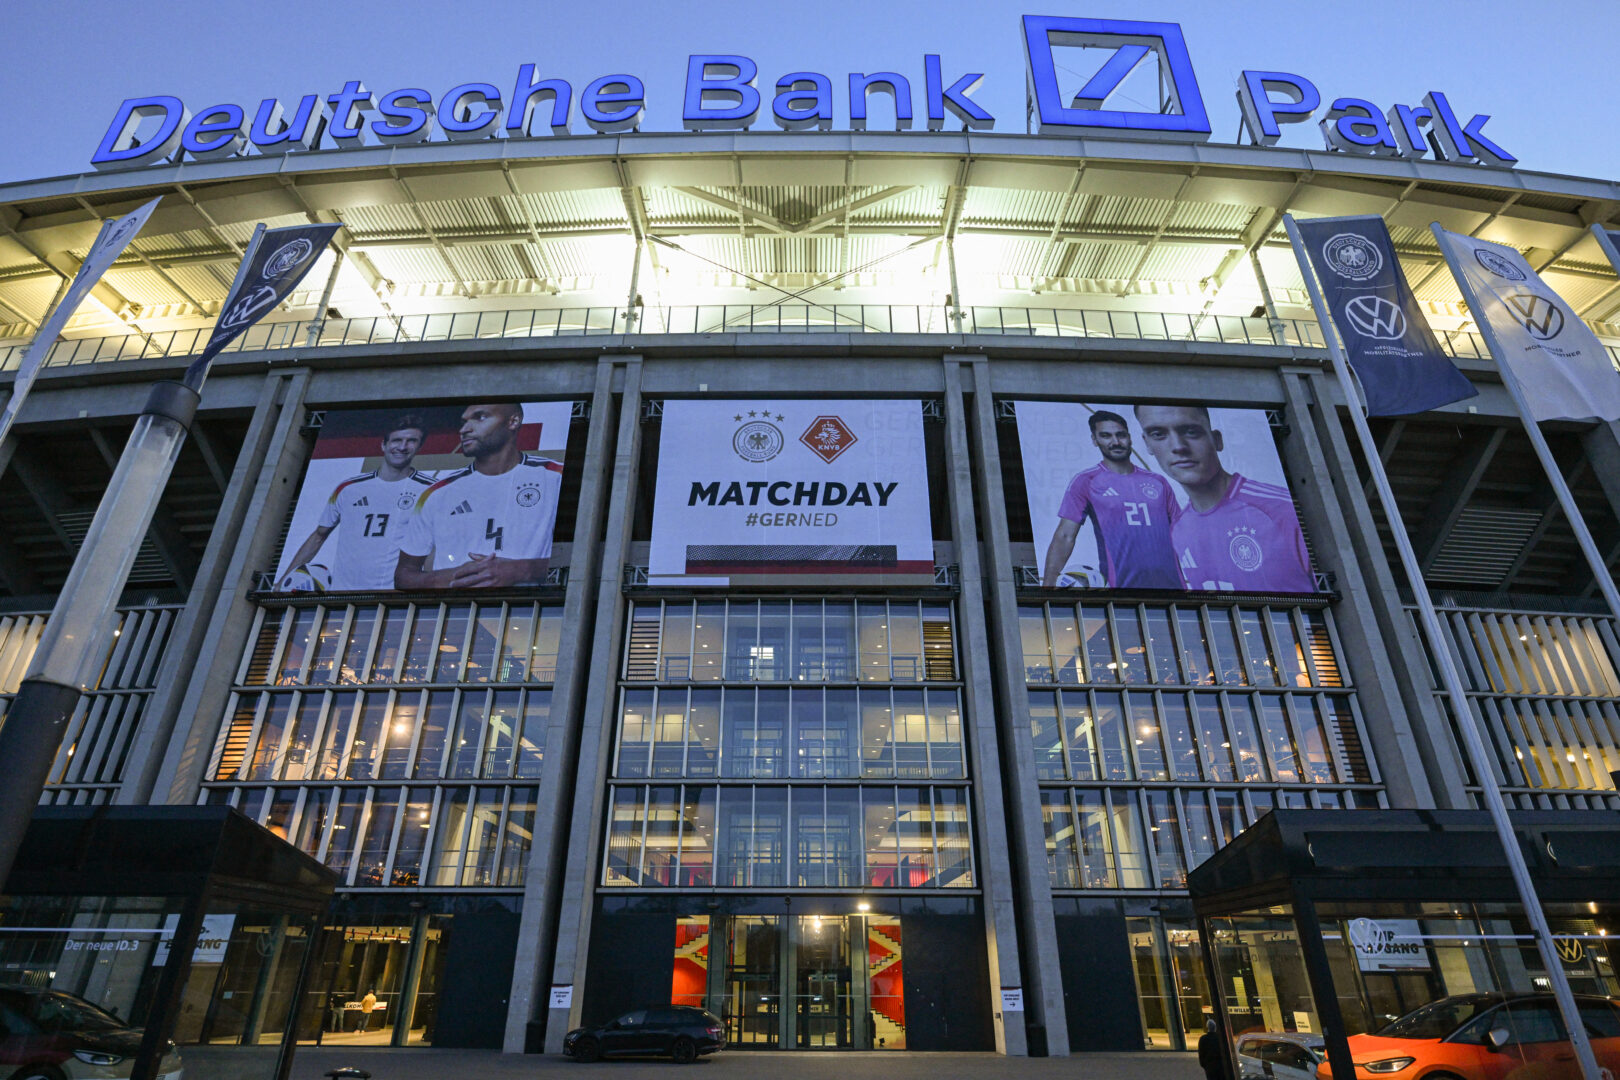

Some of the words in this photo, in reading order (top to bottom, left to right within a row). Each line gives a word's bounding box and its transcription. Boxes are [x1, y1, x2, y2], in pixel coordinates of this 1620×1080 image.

[91, 63, 646, 168] Deutsche
[682, 53, 995, 132] Bank
[1239, 69, 1518, 168] Park
[687, 481, 899, 507] MATCHDAY
[363, 513, 390, 537] 13
[745, 512, 838, 527] #GERNED
[1123, 502, 1151, 526] 21
[485, 518, 503, 550] 4
[64, 939, 85, 951] Der
[86, 941, 114, 951] neue
[115, 940, 139, 951] ID.3
